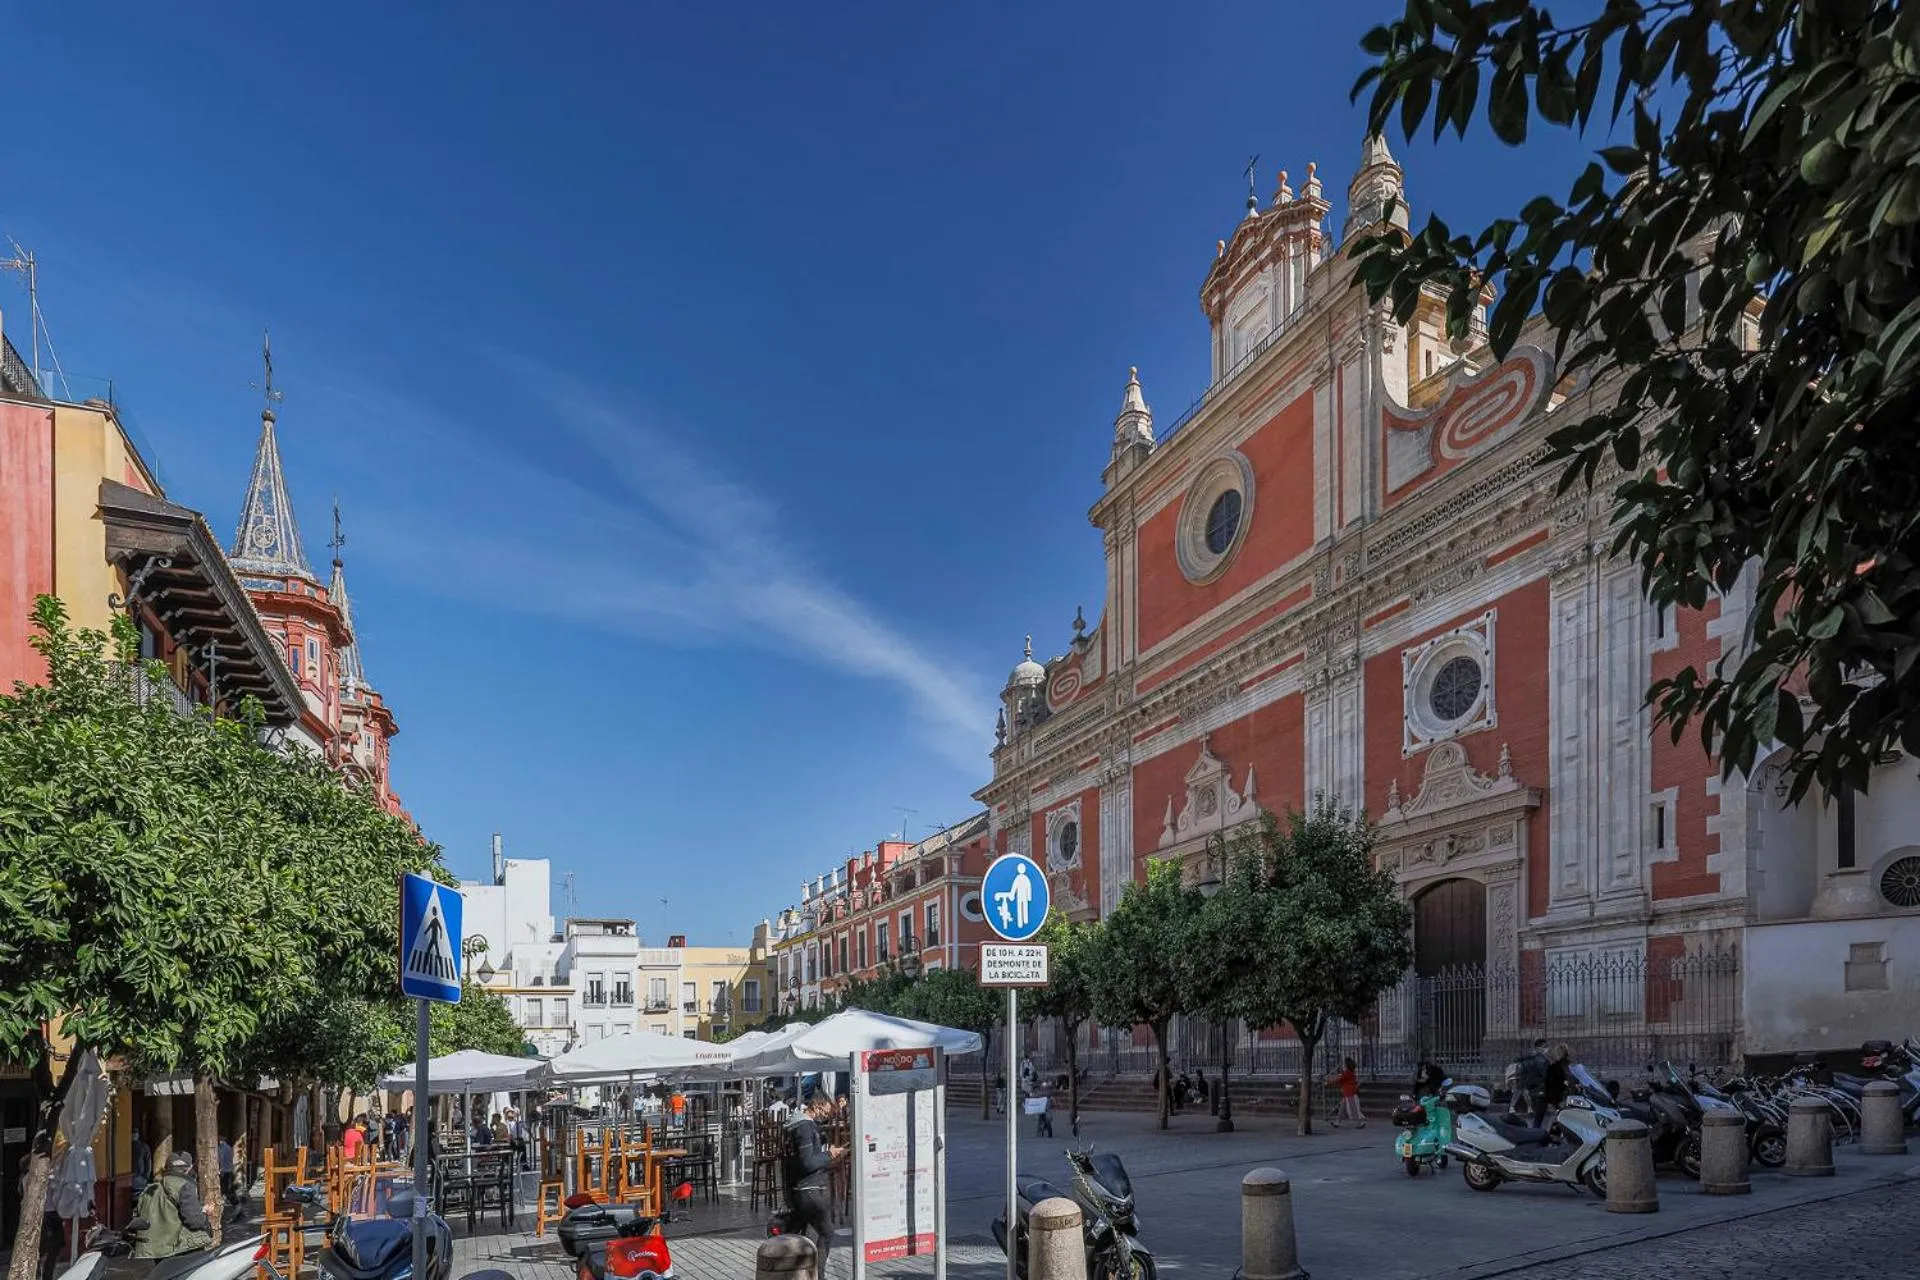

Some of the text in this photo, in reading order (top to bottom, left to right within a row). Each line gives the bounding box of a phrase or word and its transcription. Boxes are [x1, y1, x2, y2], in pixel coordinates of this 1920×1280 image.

[986, 948, 996, 957] DE
[1018, 948, 1023, 957] A
[987, 960, 1041, 968] DESMONTE DE
[989, 971, 1040, 979] LA BICICLETA
